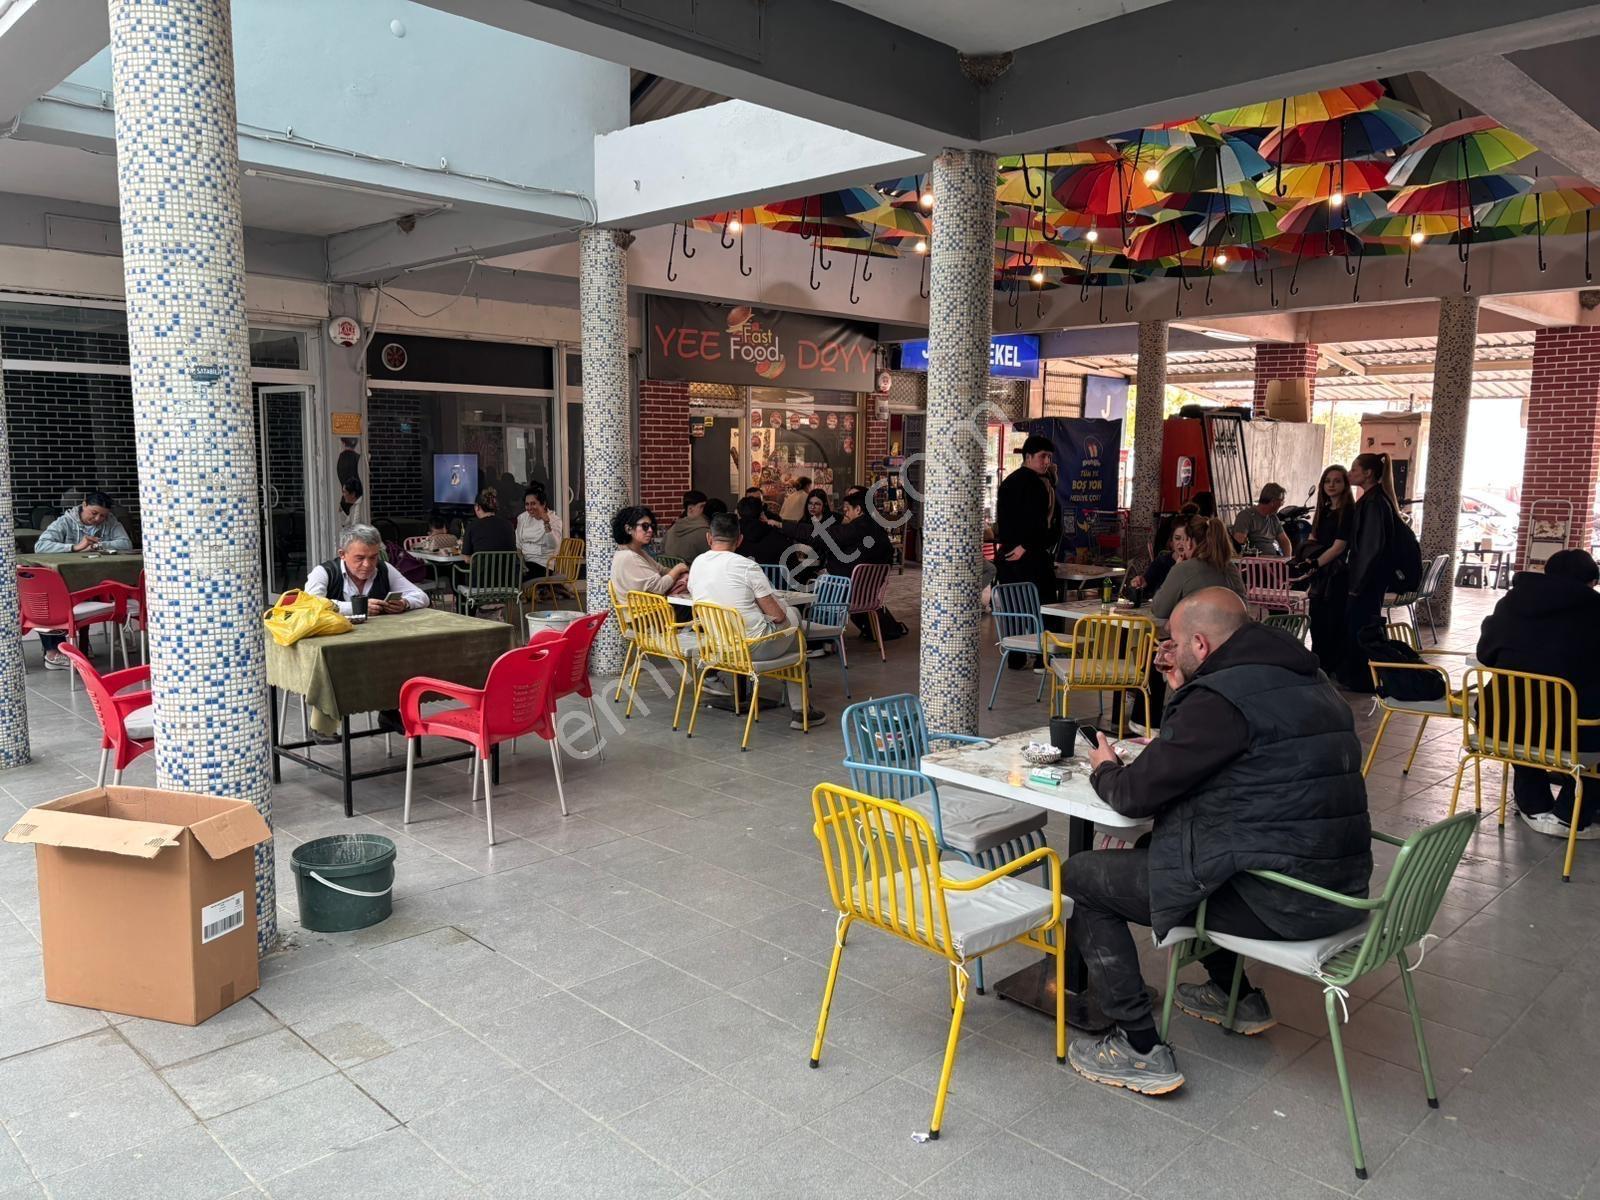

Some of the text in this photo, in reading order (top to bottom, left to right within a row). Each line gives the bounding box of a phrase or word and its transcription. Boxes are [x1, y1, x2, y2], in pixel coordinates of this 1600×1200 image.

[655, 324, 721, 361] YEE
[742, 325, 773, 345] Fast
[730, 336, 780, 362] Food
